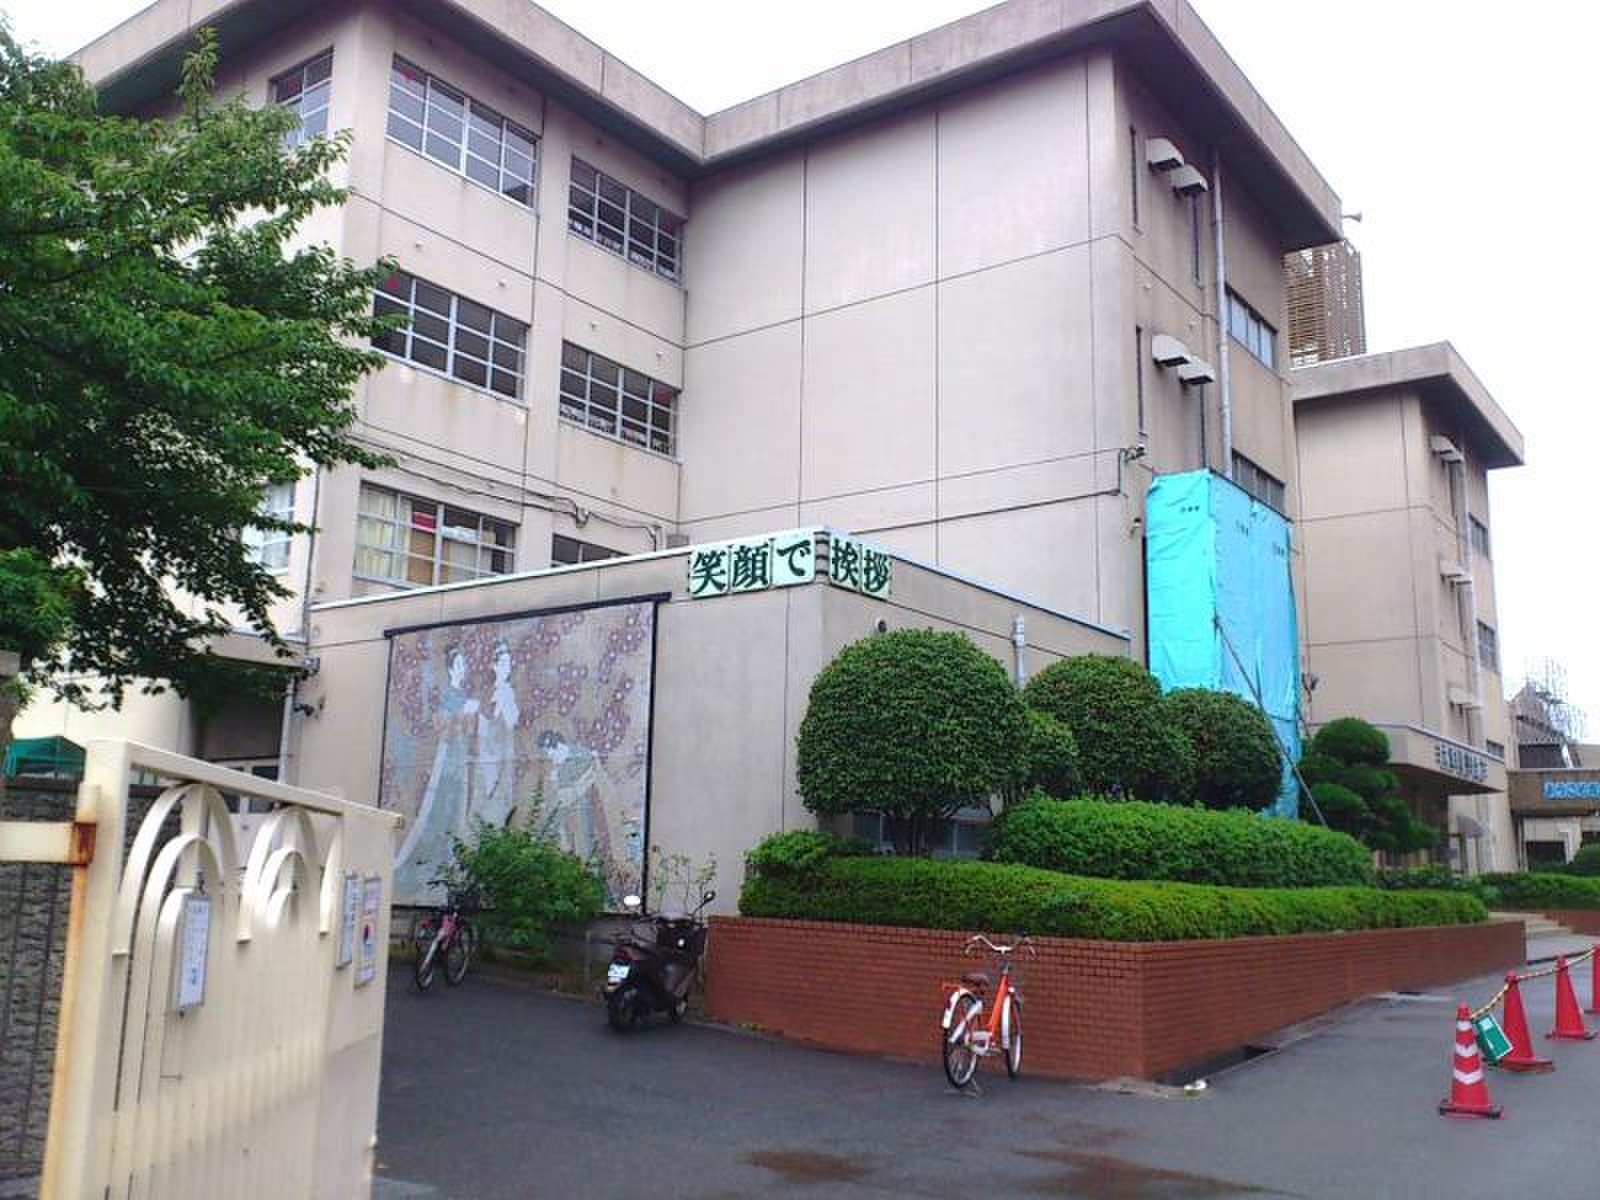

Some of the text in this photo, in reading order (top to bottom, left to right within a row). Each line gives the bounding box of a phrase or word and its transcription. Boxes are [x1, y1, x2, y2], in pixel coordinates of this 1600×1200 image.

[692, 538, 890, 594] 笑顔で 挨拶
